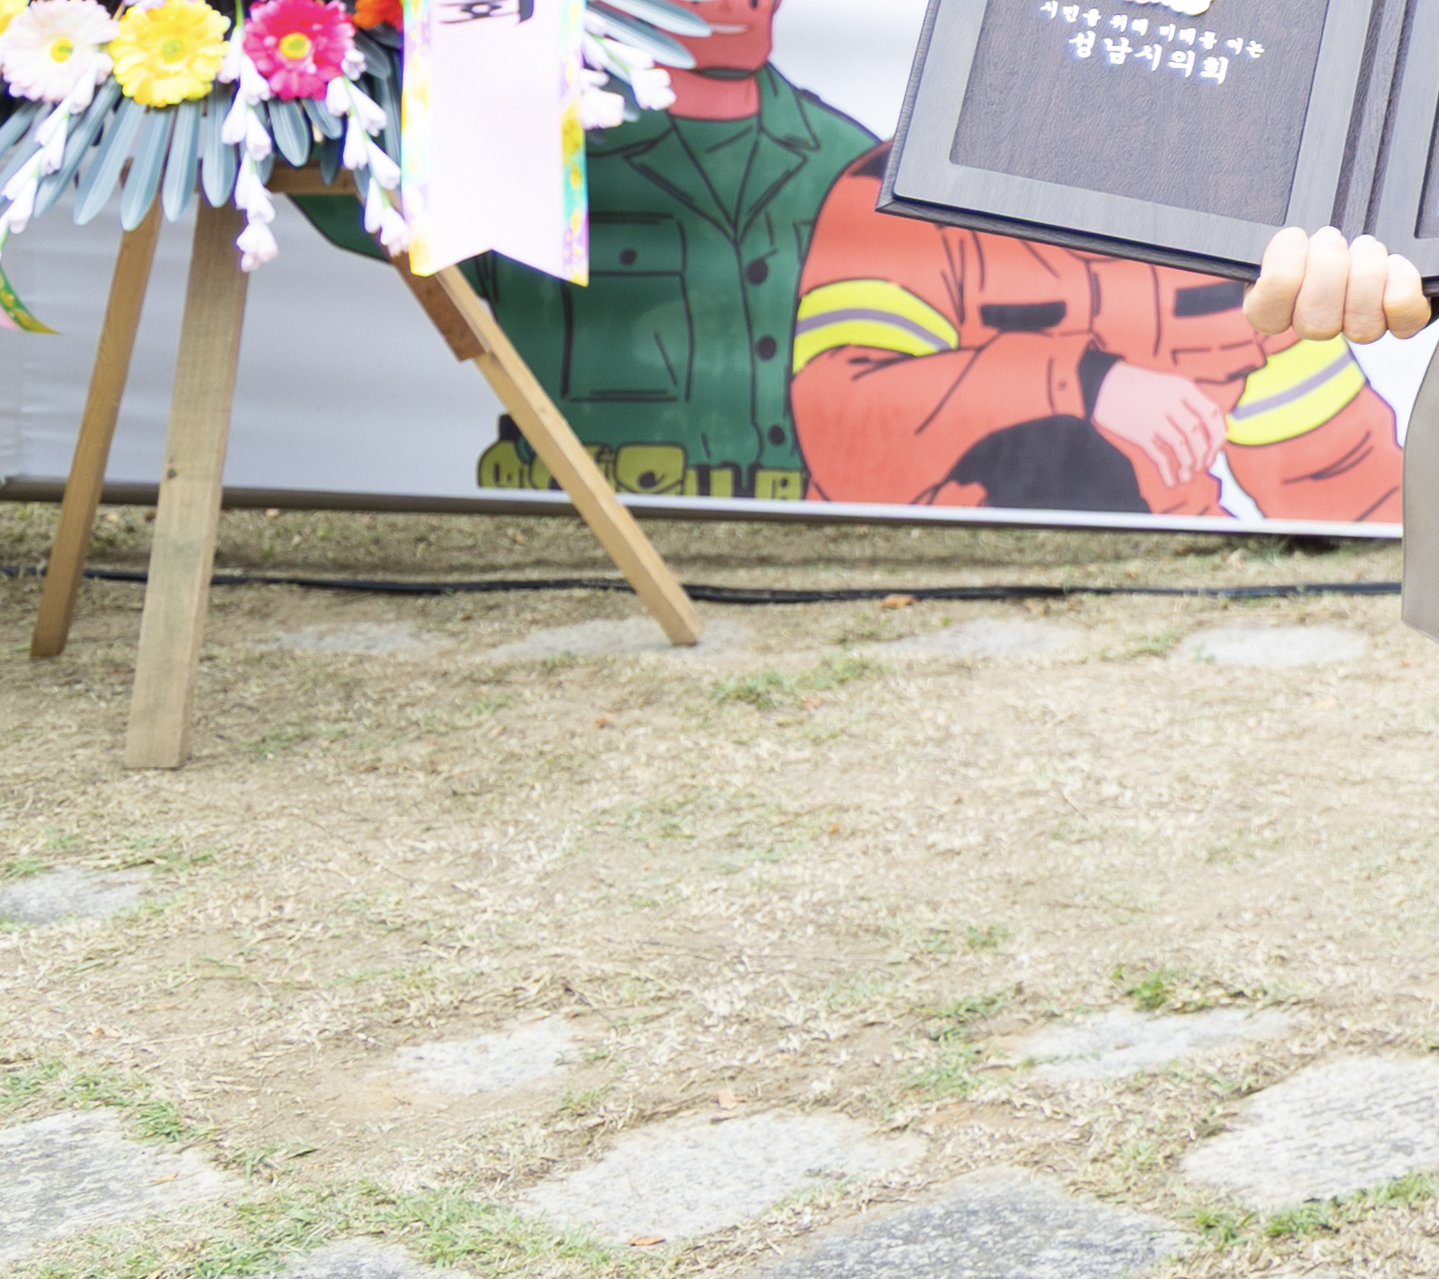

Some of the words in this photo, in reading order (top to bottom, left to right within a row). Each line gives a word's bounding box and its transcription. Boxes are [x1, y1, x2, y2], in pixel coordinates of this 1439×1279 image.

[1040, 0, 1102, 28] 시민을
[1109, 14, 1149, 36] 위해
[1068, 30, 1230, 85] 성남시의회
